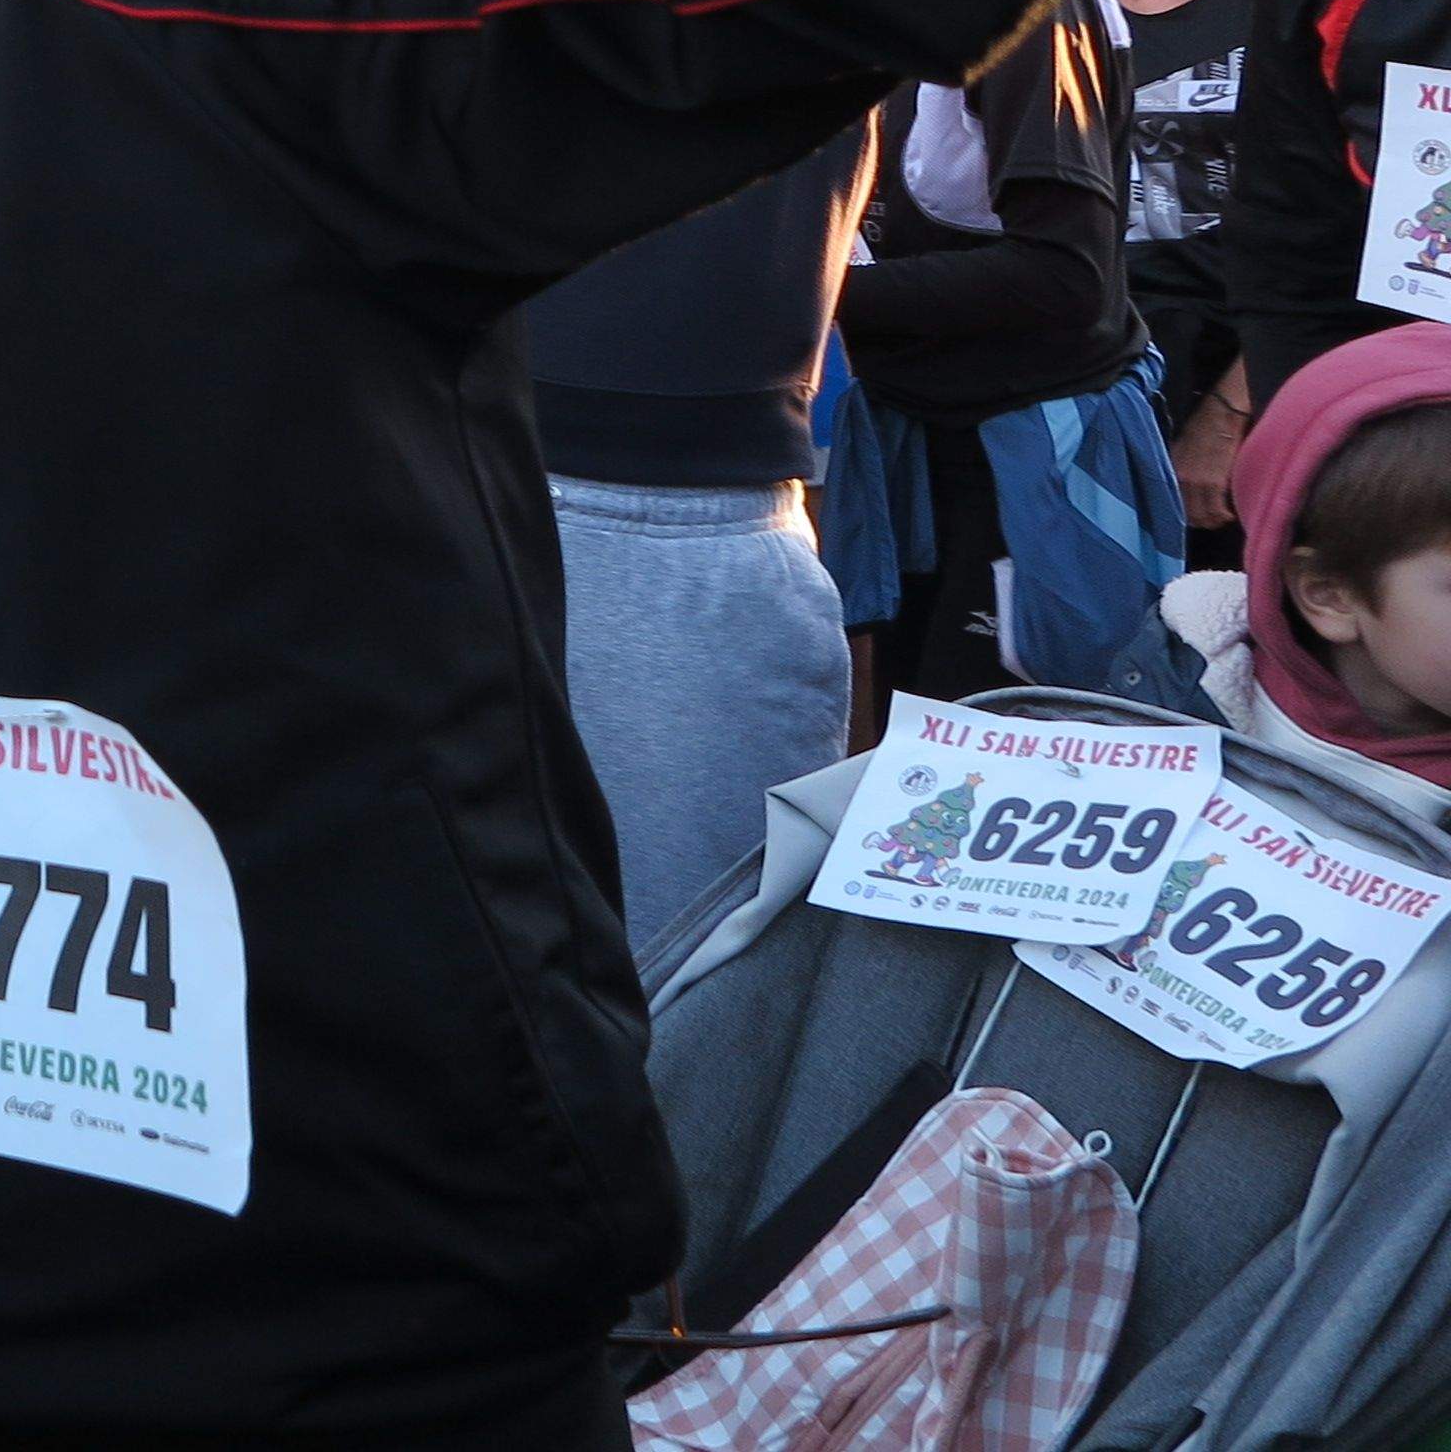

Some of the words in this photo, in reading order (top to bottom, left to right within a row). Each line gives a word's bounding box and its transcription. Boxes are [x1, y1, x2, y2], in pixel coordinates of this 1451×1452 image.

[919, 714, 971, 747] XLI
[977, 730, 1040, 758] SAN
[1045, 736, 1198, 772] SILVESTRE
[967, 796, 1177, 874] 6259
[1239, 825, 1309, 868] SAN
[946, 875, 1070, 903] PONTEVEDRA
[1075, 888, 1130, 909] 2024
[1170, 887, 1386, 1029] 6258
[1138, 962, 1248, 1034] PONTEVEDRA
[133, 1065, 208, 1114] 2024
